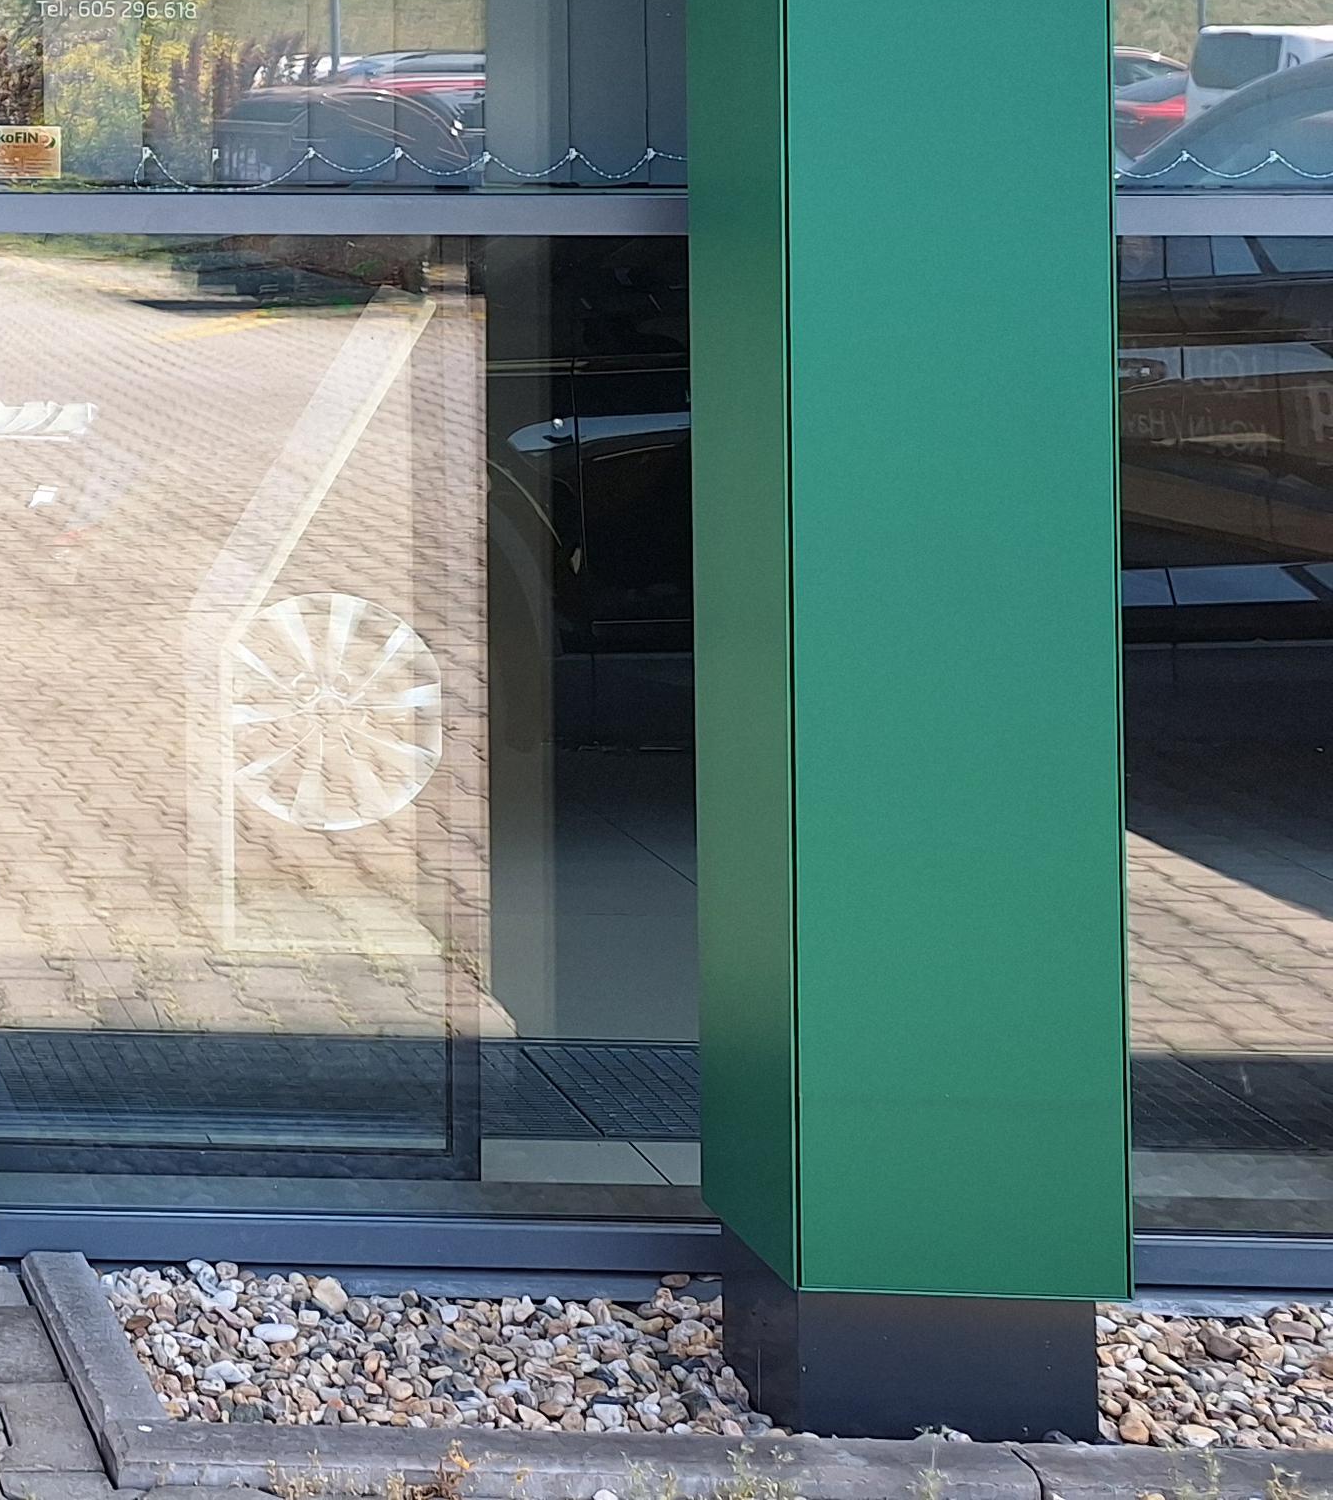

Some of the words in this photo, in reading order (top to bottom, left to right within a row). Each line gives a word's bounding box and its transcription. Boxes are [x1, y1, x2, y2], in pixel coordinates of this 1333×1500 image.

[36, 0, 73, 18] Tel.:
[78, 0, 116, 18] 605
[121, 0, 159, 19] 296
[164, 1, 197, 19] 618
